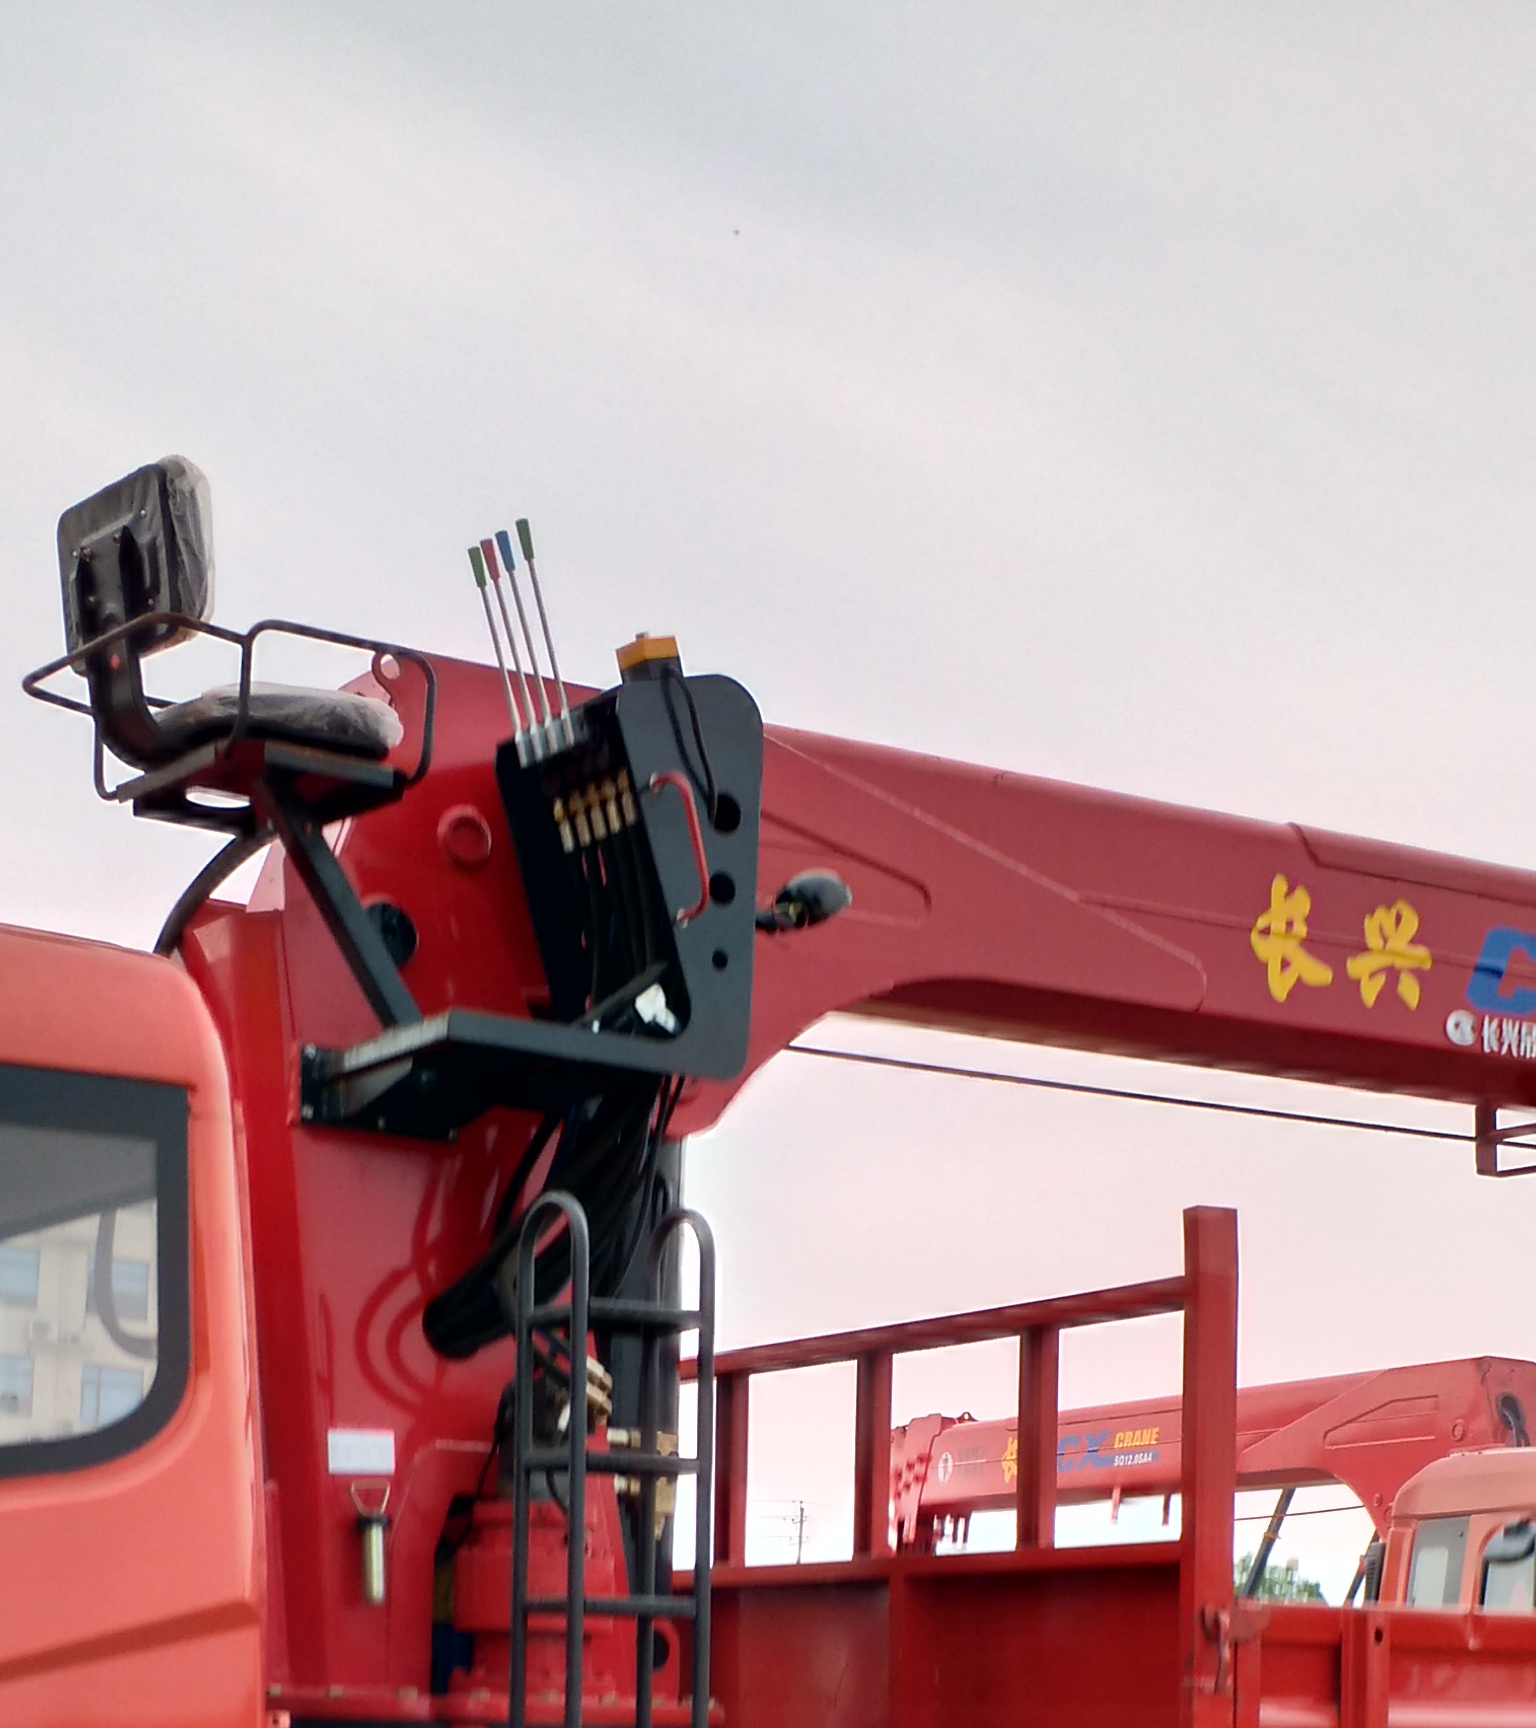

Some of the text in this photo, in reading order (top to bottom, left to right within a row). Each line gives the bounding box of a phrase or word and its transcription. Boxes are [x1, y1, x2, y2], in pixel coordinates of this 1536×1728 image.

[1250, 872, 1433, 1011] 长兴
[1057, 1430, 1113, 1472] CX
[1113, 1427, 1160, 1449] CRANE
